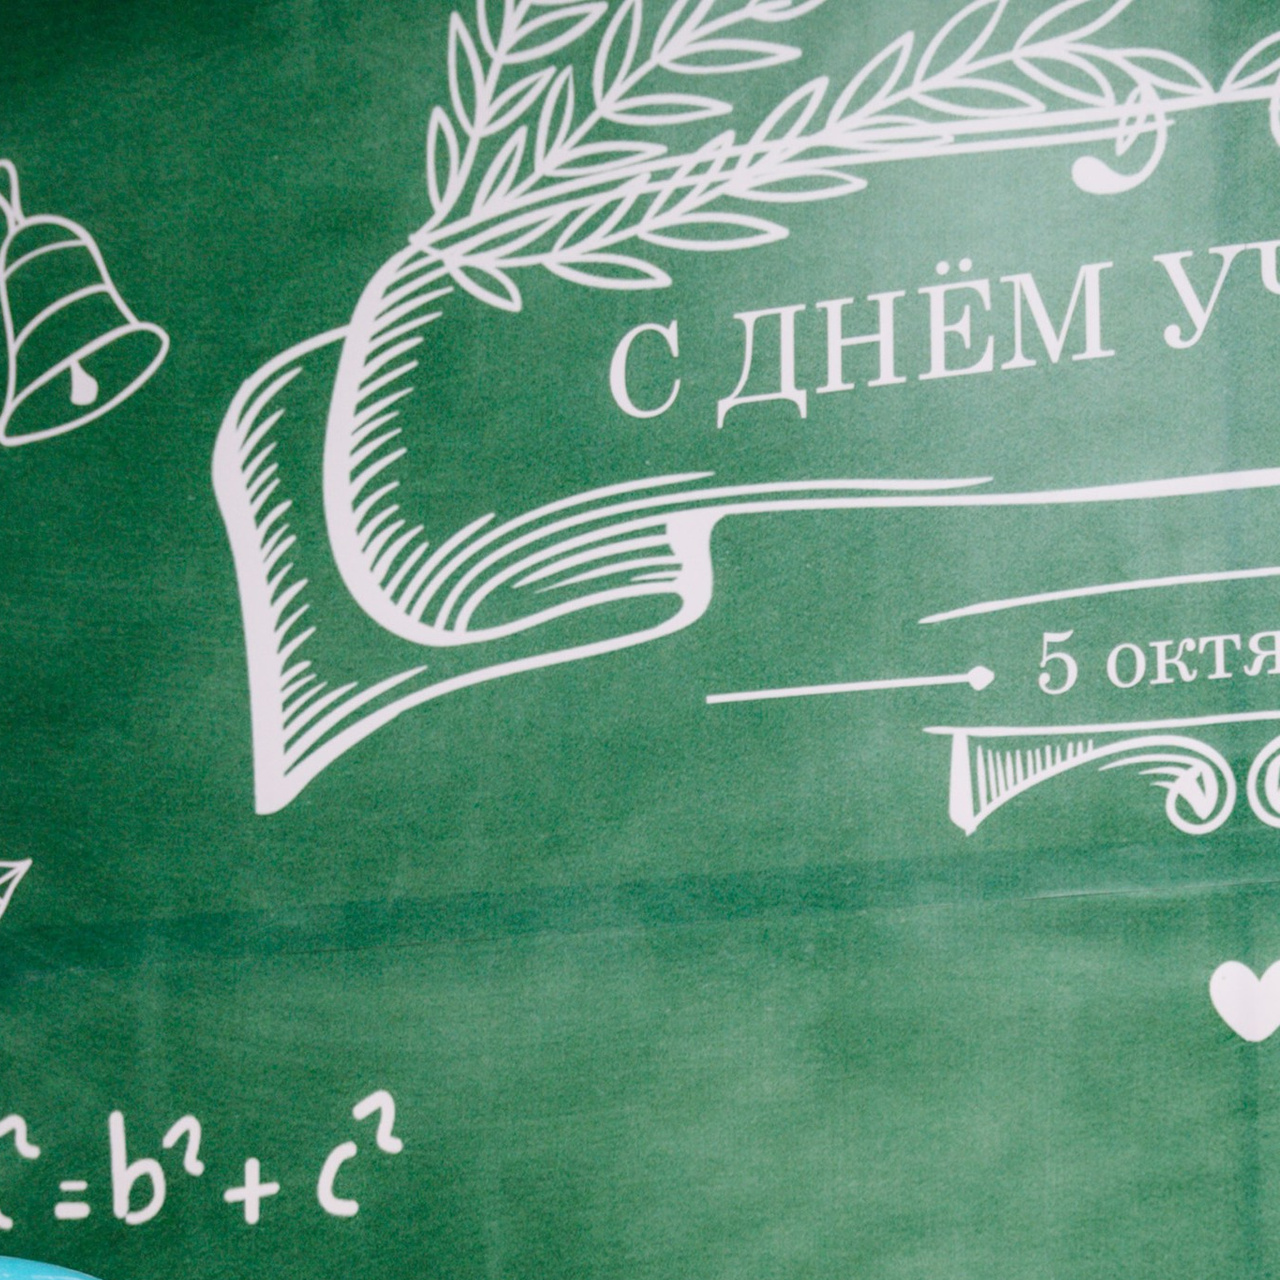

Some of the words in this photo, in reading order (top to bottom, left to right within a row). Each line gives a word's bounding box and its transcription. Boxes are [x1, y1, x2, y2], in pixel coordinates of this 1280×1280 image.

[608, 320, 681, 420] С
[715, 258, 1117, 431] ДНЁМ
[1037, 629, 1079, 696] 5
